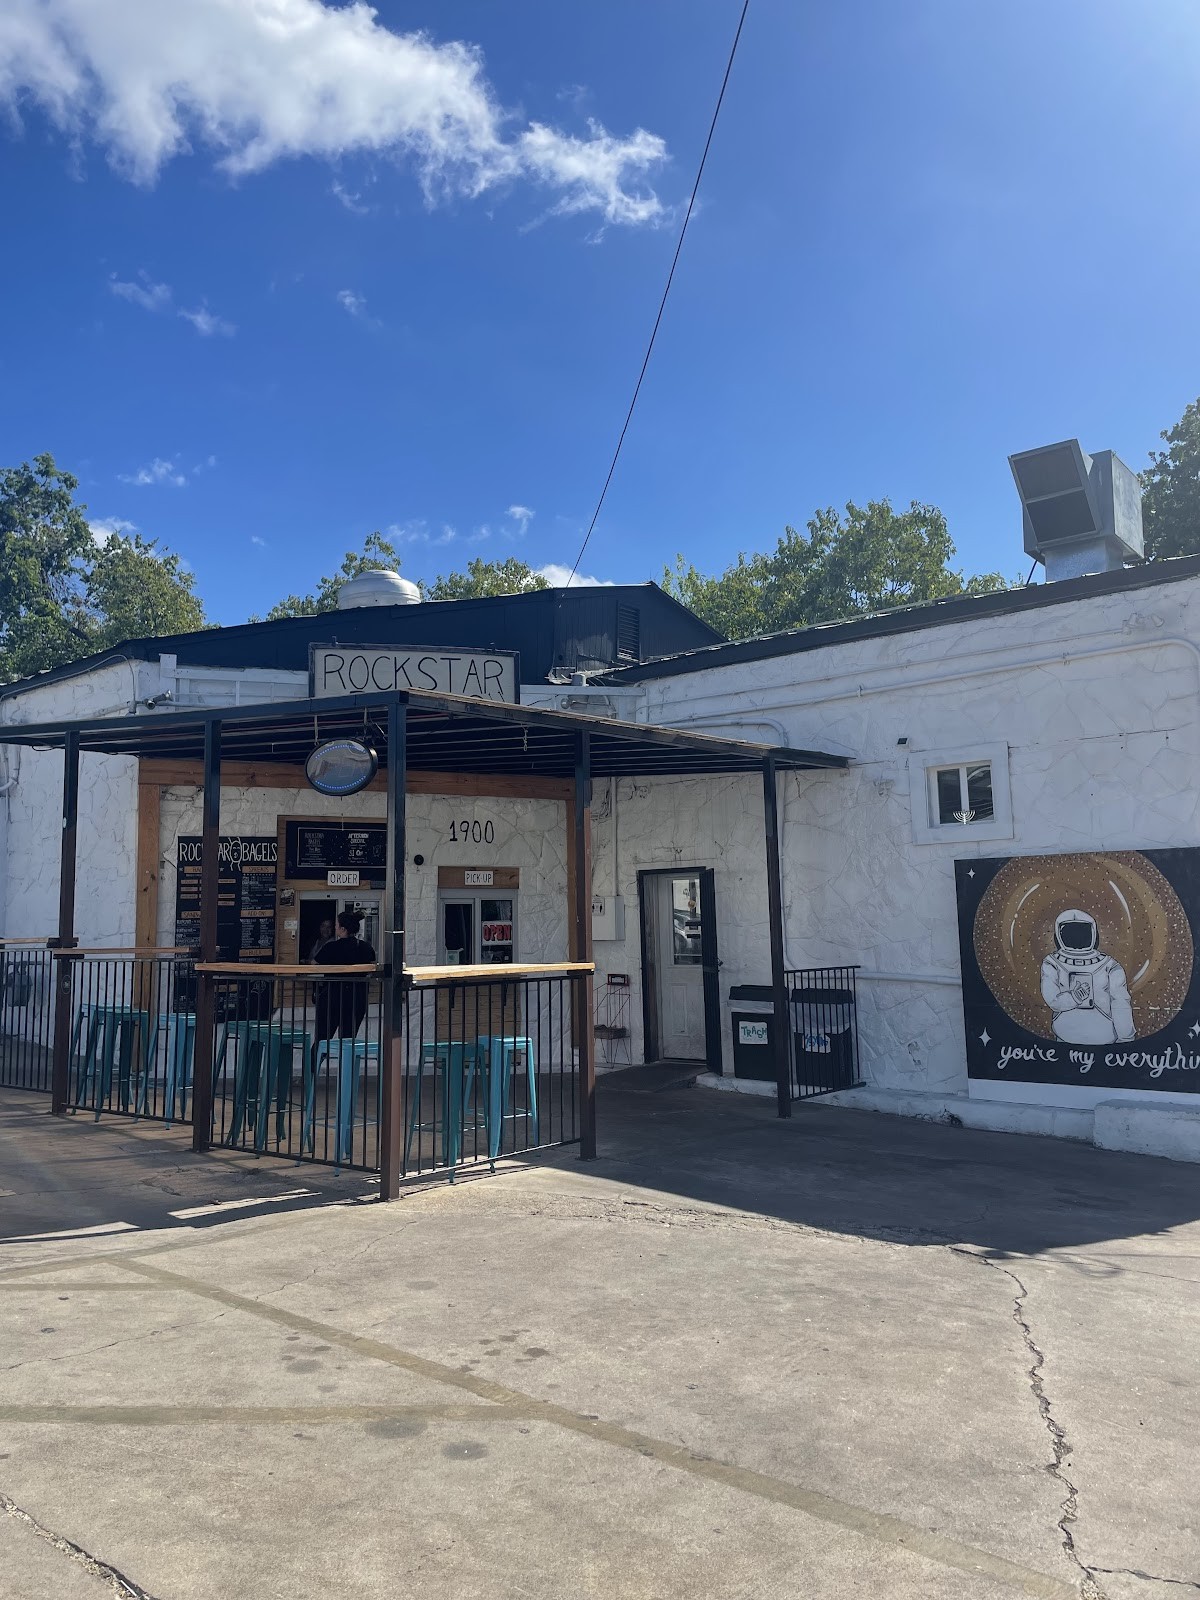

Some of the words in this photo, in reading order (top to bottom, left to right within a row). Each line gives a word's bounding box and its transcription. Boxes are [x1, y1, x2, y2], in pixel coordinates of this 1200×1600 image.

[323, 653, 504, 695] ROCKSTAR
[449, 820, 494, 843] 1900
[180, 843, 231, 861] ROCAR
[242, 842, 277, 861] BAGELS
[330, 873, 358, 884] ORDER
[466, 873, 492, 883] PICK-UP
[483, 924, 512, 941] OPEN
[741, 1025, 768, 1038] TRASH
[998, 1044, 1059, 1070] you're
[1069, 1049, 1095, 1073] my
